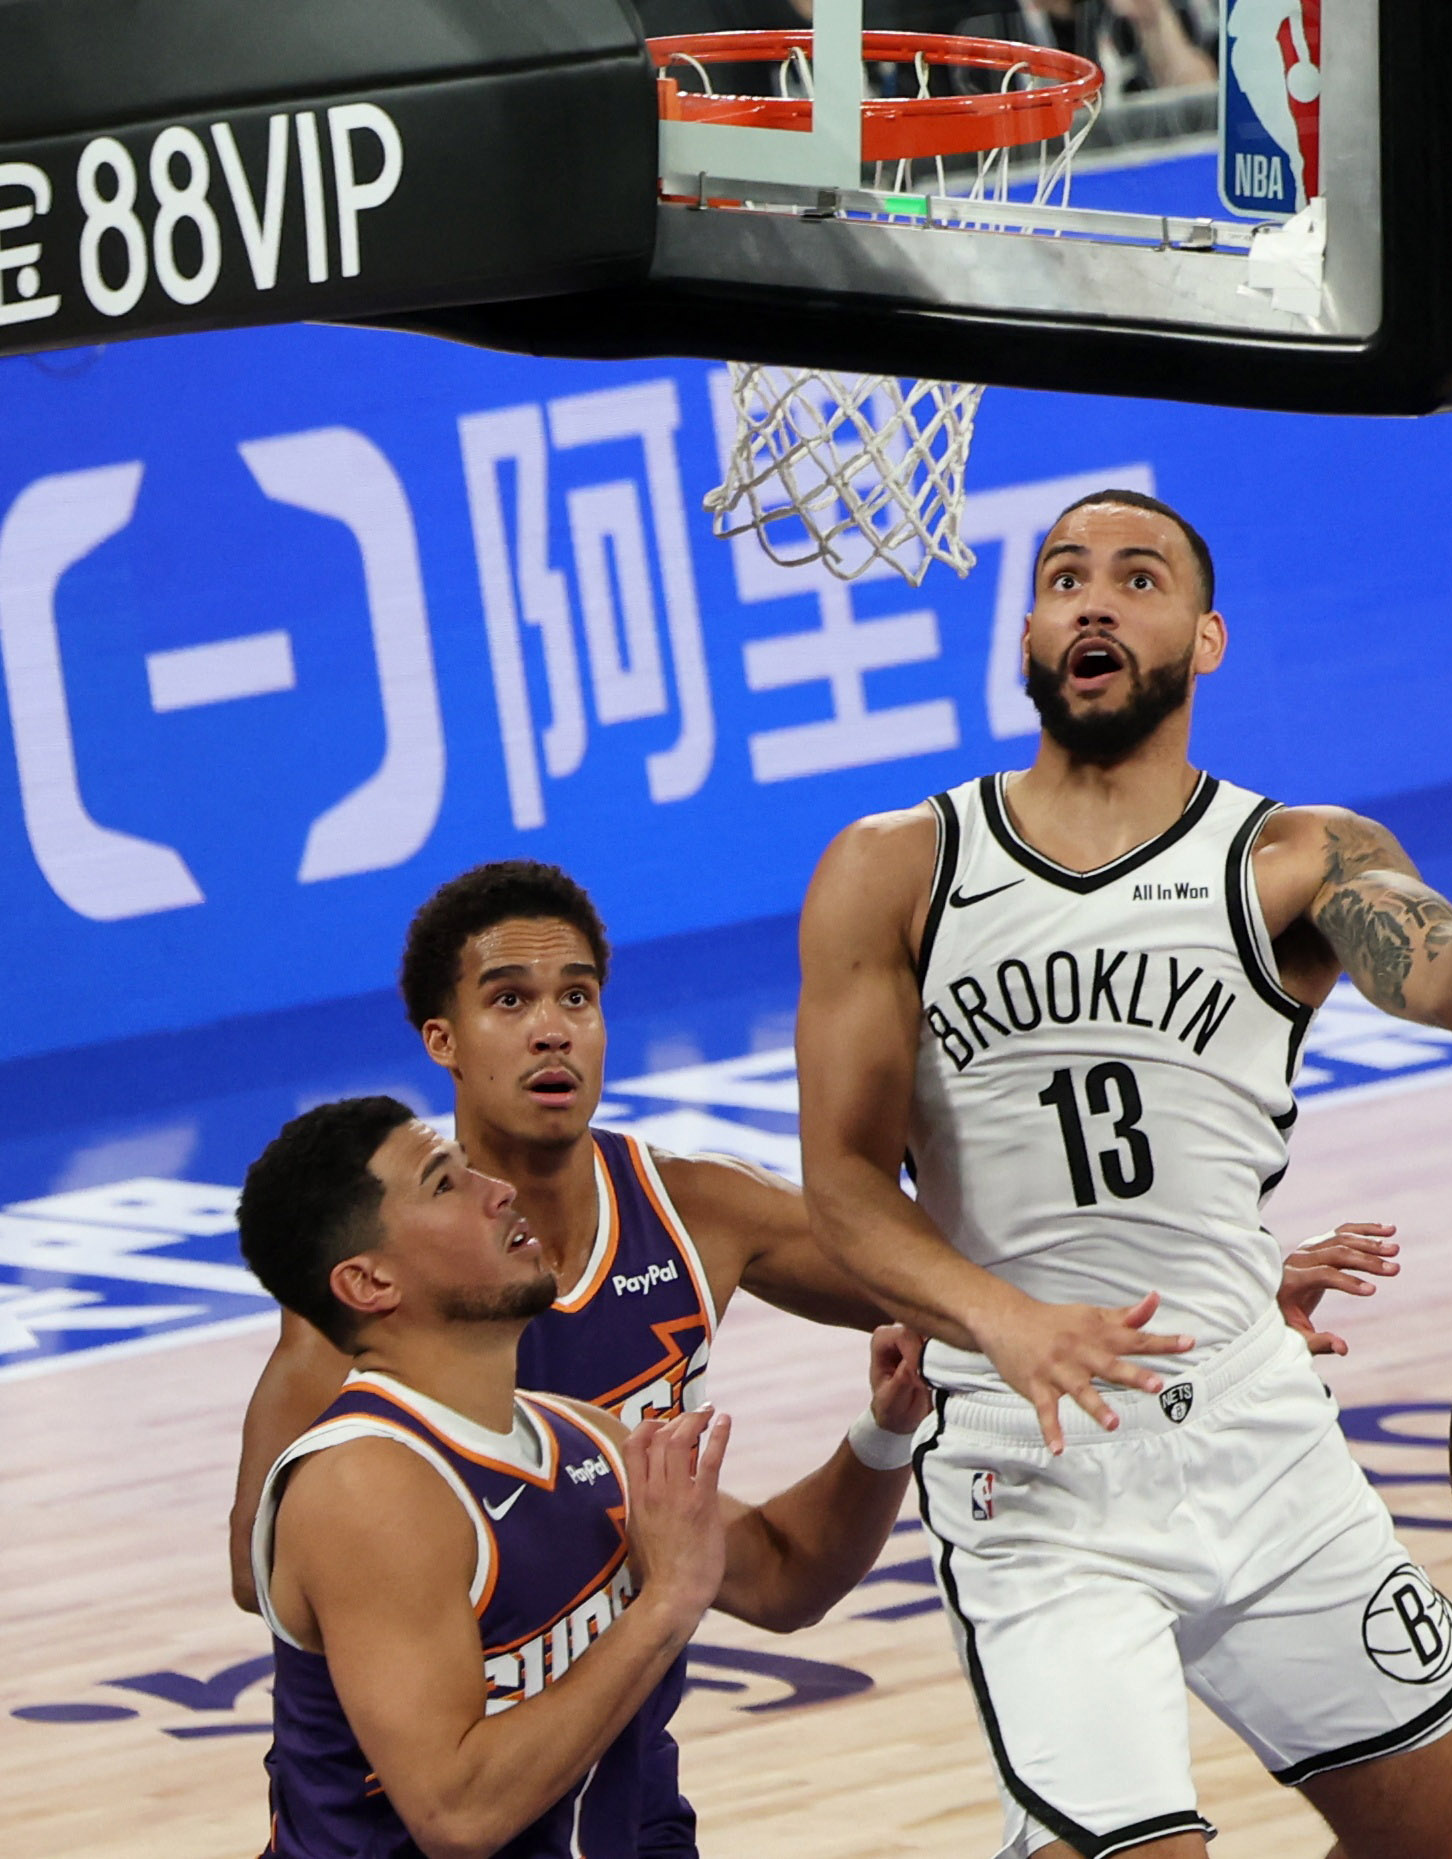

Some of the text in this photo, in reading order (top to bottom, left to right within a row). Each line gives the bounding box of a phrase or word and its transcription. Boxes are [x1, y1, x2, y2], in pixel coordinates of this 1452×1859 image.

[1234, 153, 1285, 201] NBA
[1132, 882, 1209, 901] All In Won
[926, 948, 1237, 1072] BROOKLYN
[1038, 1061, 1155, 1209] 13
[611, 1259, 679, 1296] PayPal
[1161, 1384, 1193, 1410] NETS
[565, 1454, 611, 1487] PayPal
[1391, 1583, 1444, 1668] B
